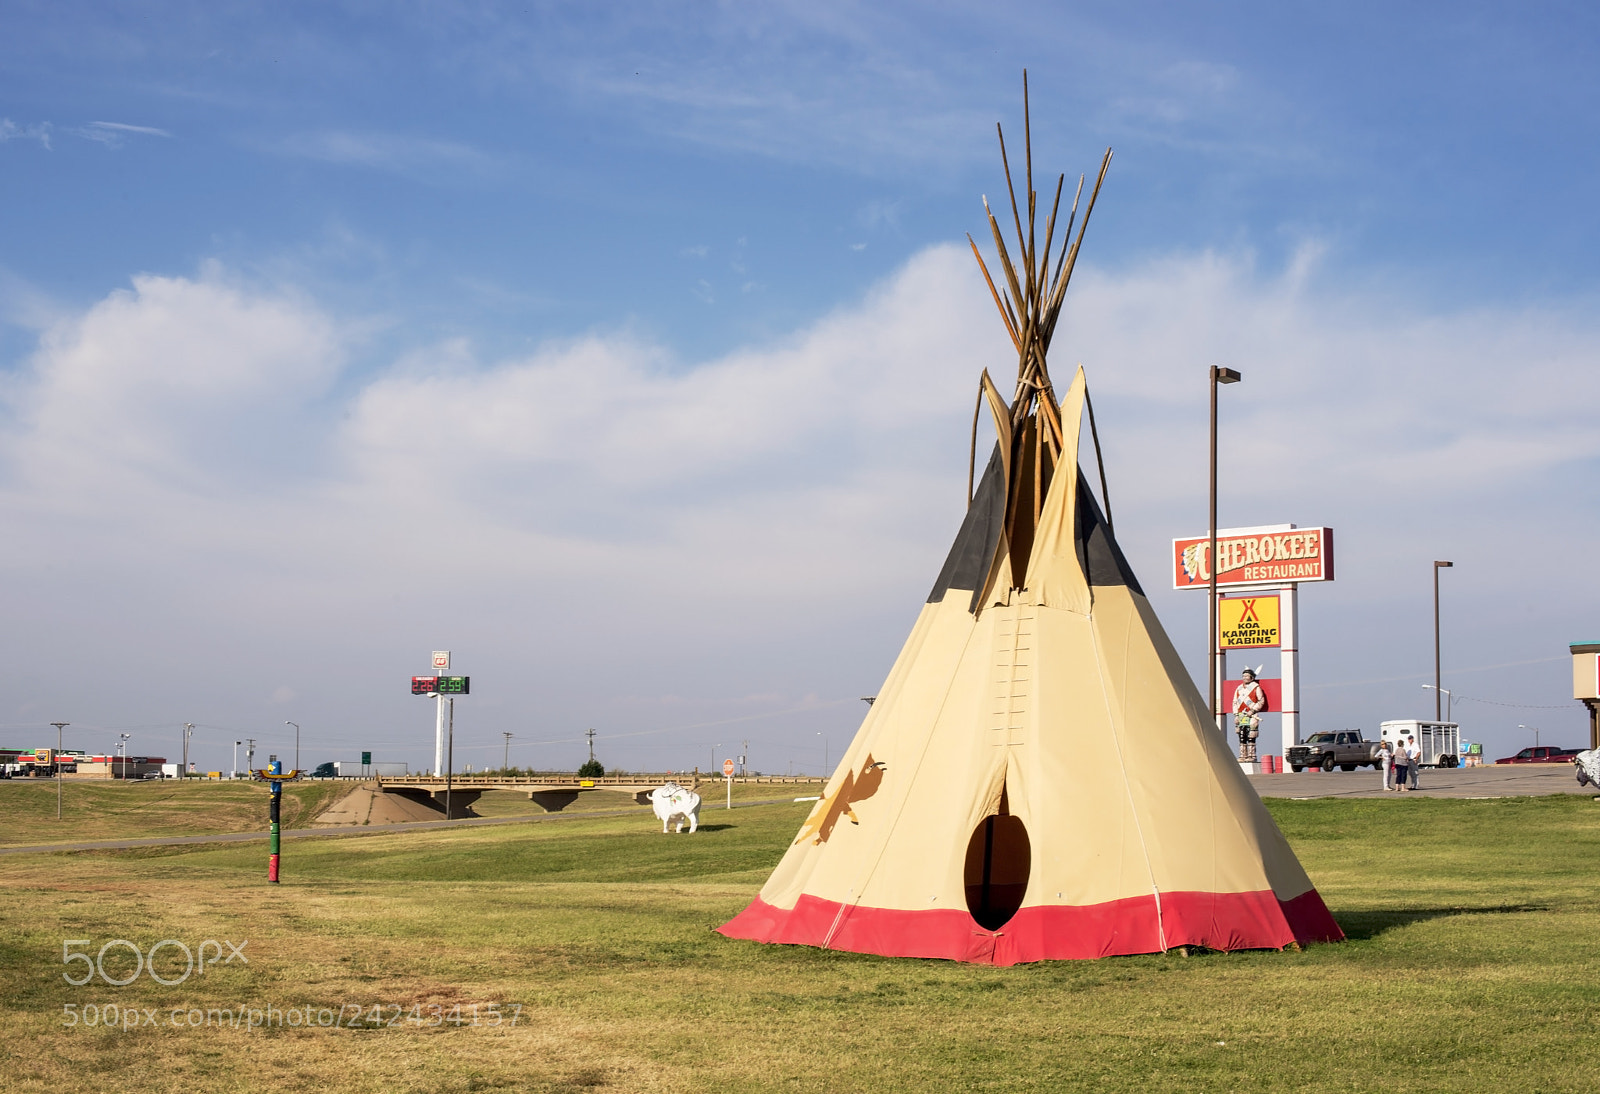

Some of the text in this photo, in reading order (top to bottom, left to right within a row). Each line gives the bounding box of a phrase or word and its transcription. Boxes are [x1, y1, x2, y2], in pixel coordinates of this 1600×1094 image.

[1198, 533, 1318, 581] CHEROKEE
[1244, 562, 1320, 580] RESTAURANT
[1222, 629, 1277, 638] KAMPING
[1227, 637, 1271, 645] KABINS
